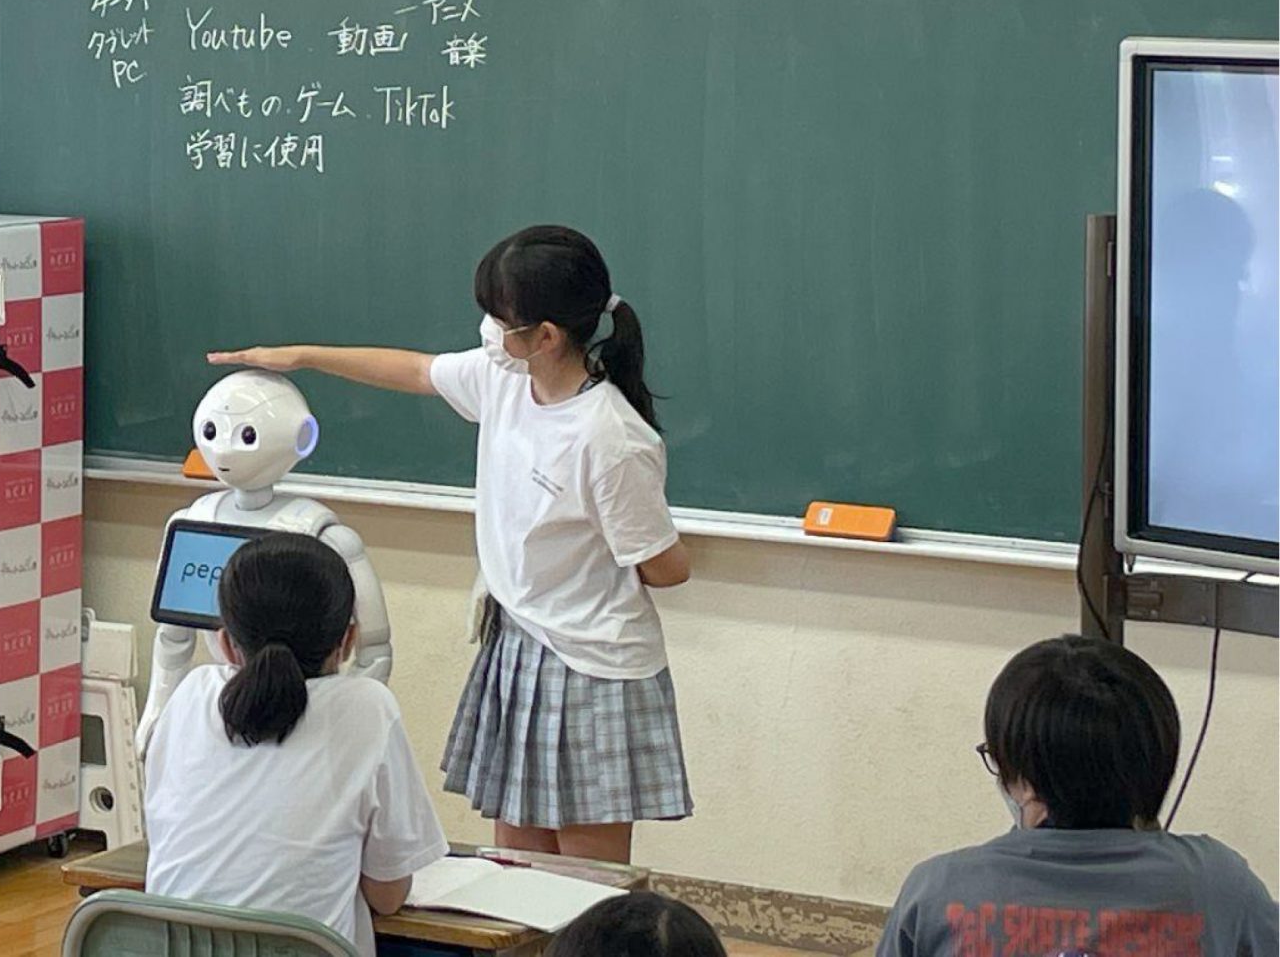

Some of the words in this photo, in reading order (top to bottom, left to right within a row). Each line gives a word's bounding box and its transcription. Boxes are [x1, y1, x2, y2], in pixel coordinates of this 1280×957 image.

[185, 6, 293, 51] Youtube
[327, 16, 409, 57] 動画
[440, 30, 489, 69] 音楽
[112, 59, 148, 89] PC
[373, 84, 457, 130] TikTok
[185, 128, 325, 174] 学習に使用
